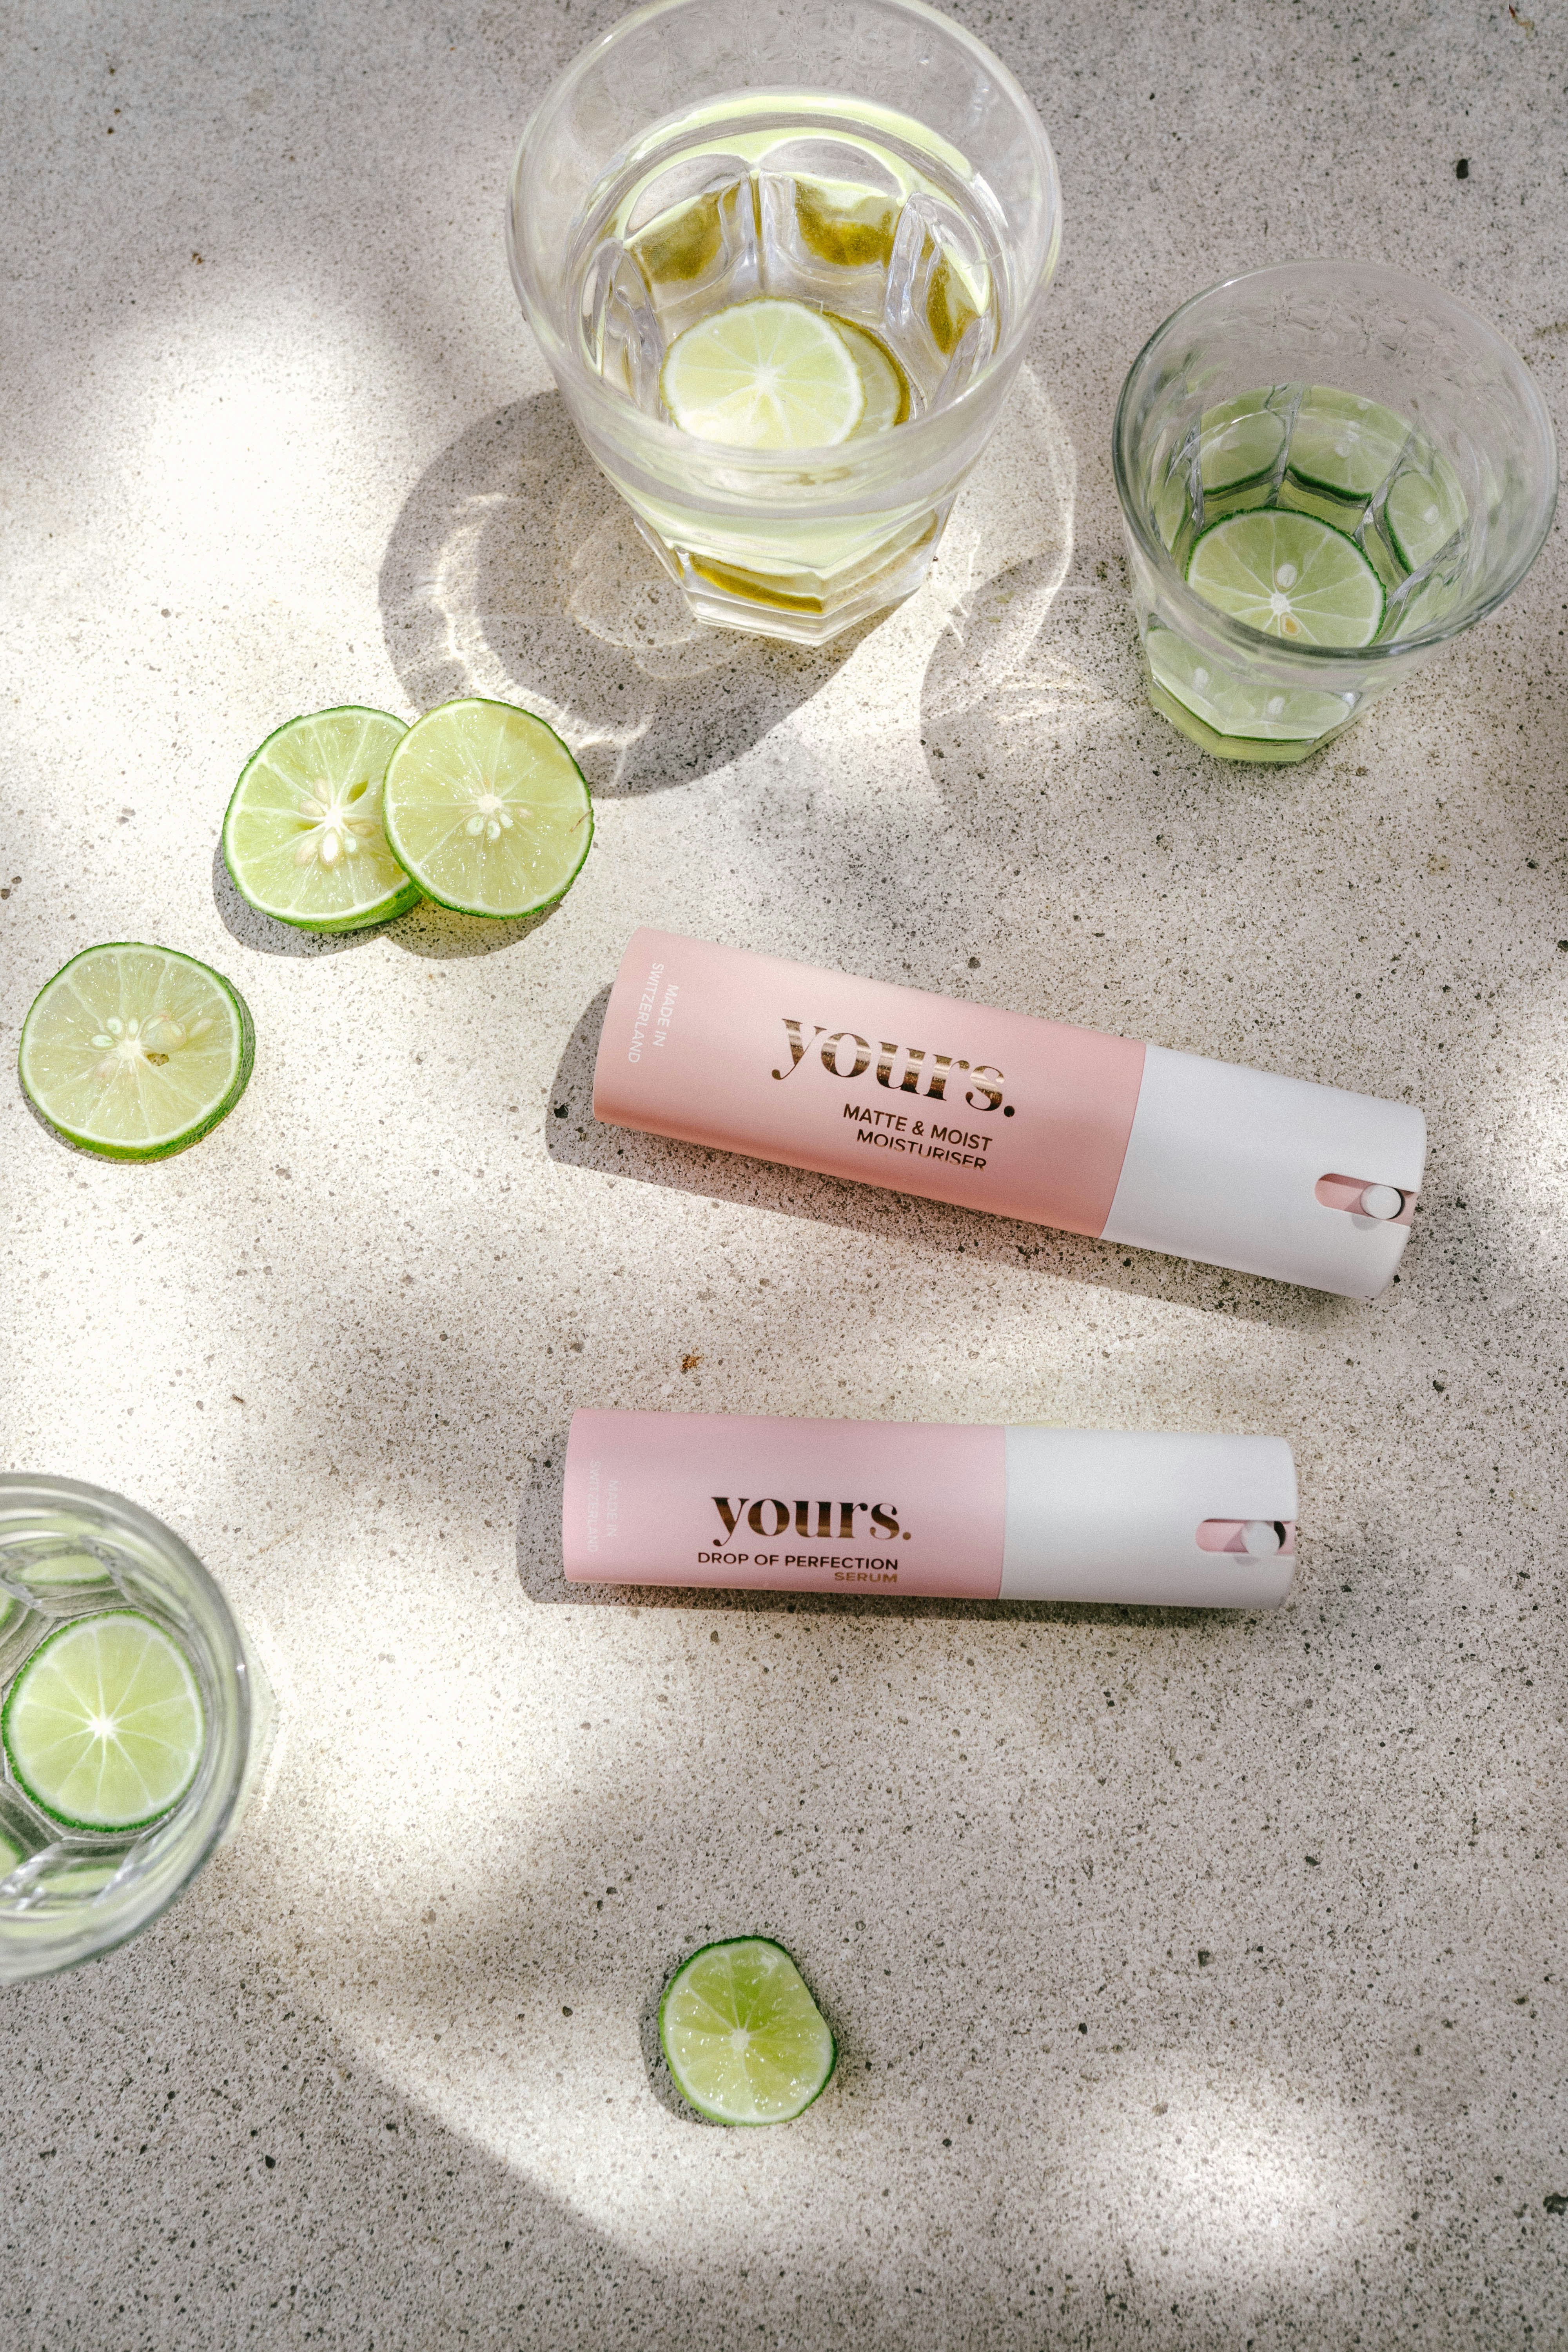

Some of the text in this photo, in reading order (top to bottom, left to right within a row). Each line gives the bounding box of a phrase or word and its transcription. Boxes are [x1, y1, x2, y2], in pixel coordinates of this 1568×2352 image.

[628, 962, 664, 1063] SWITZERLAND
[653, 984, 679, 1047] MADE IN
[771, 1018, 1015, 1117] yours.
[843, 1103, 993, 1152] MATTE & MOIST
[857, 1129, 987, 1171] MOISTURISER
[711, 1497, 911, 1546] yours.
[698, 1552, 898, 1570] DROP OF PERFECTION
[834, 1572, 897, 1583] SERUM
